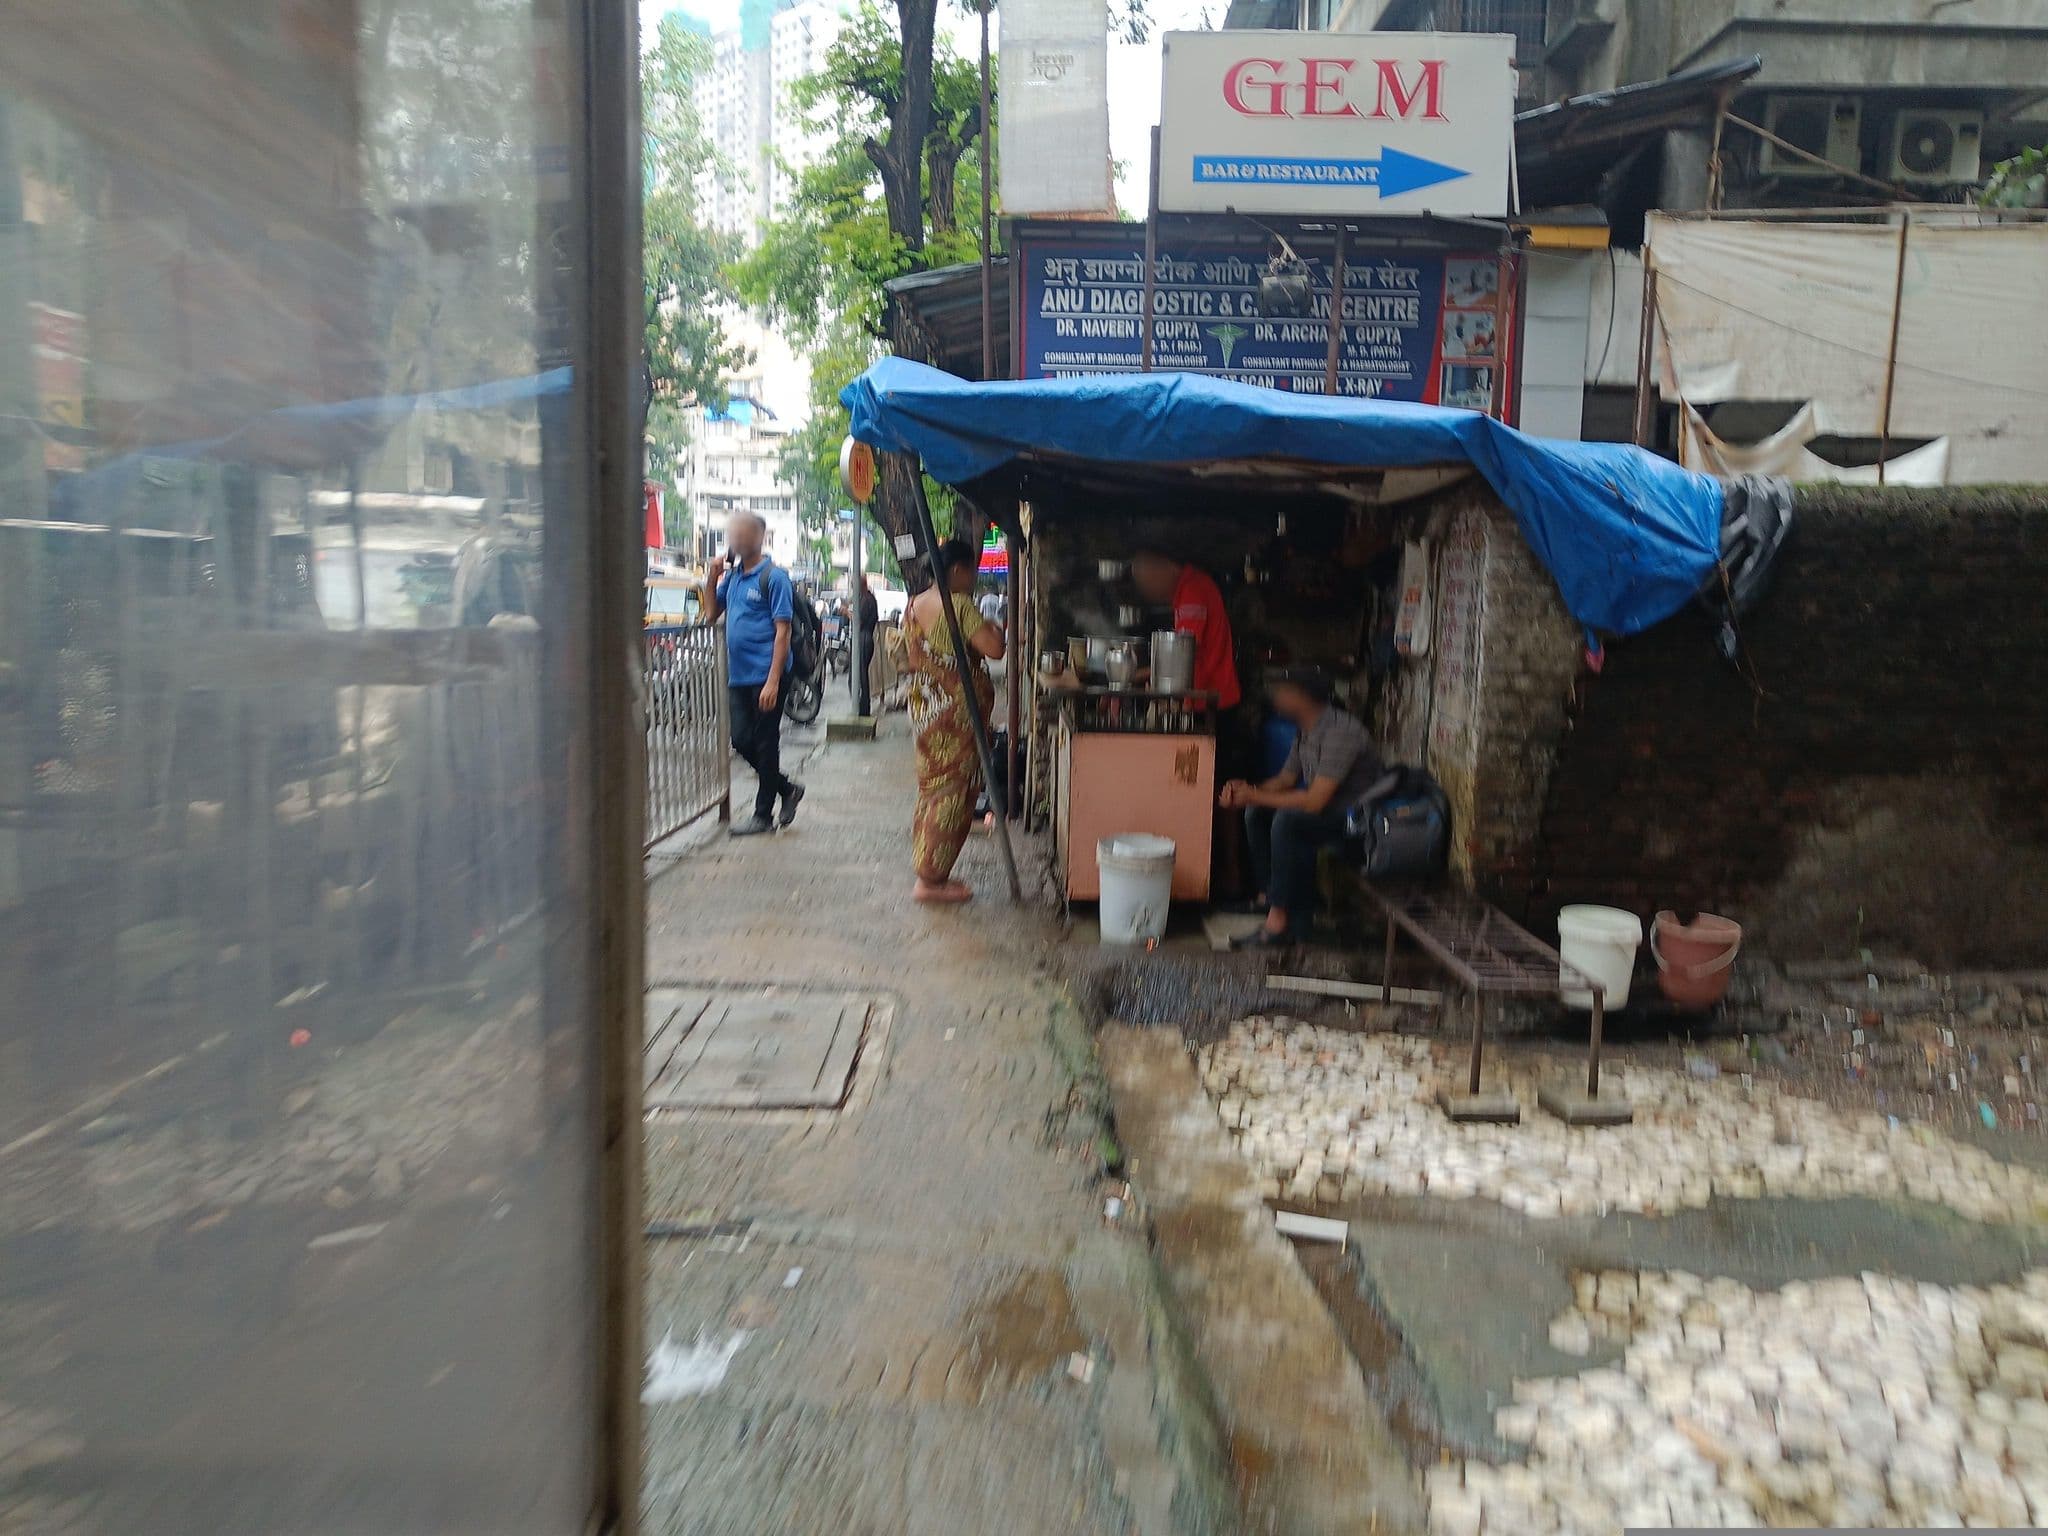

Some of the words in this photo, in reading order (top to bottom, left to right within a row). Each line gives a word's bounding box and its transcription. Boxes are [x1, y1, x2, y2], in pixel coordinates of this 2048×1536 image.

[1222, 57, 1450, 122] GEM
[1042, 288, 1084, 313] ANU
[1218, 292, 1233, 316] &
[1341, 296, 1420, 321] CENTRE
[1056, 319, 1078, 337] DR.
[1082, 319, 1135, 338] NAVEEN
[1156, 321, 1200, 339] GUPTA
[1255, 324, 1278, 342] DR.
[1281, 325, 1348, 343] ARCHAA
[1355, 326, 1402, 345] GUPTA
[1045, 352, 1096, 365] CONSULTANT
[1098, 353, 1143, 366] RADIOLOGI
[1159, 355, 1208, 368] SONOLOGIST
[1242, 356, 1289, 369] CONSULTANT
[1293, 376, 1342, 394] DIGITL
[1345, 378, 1383, 397] X-RAY
